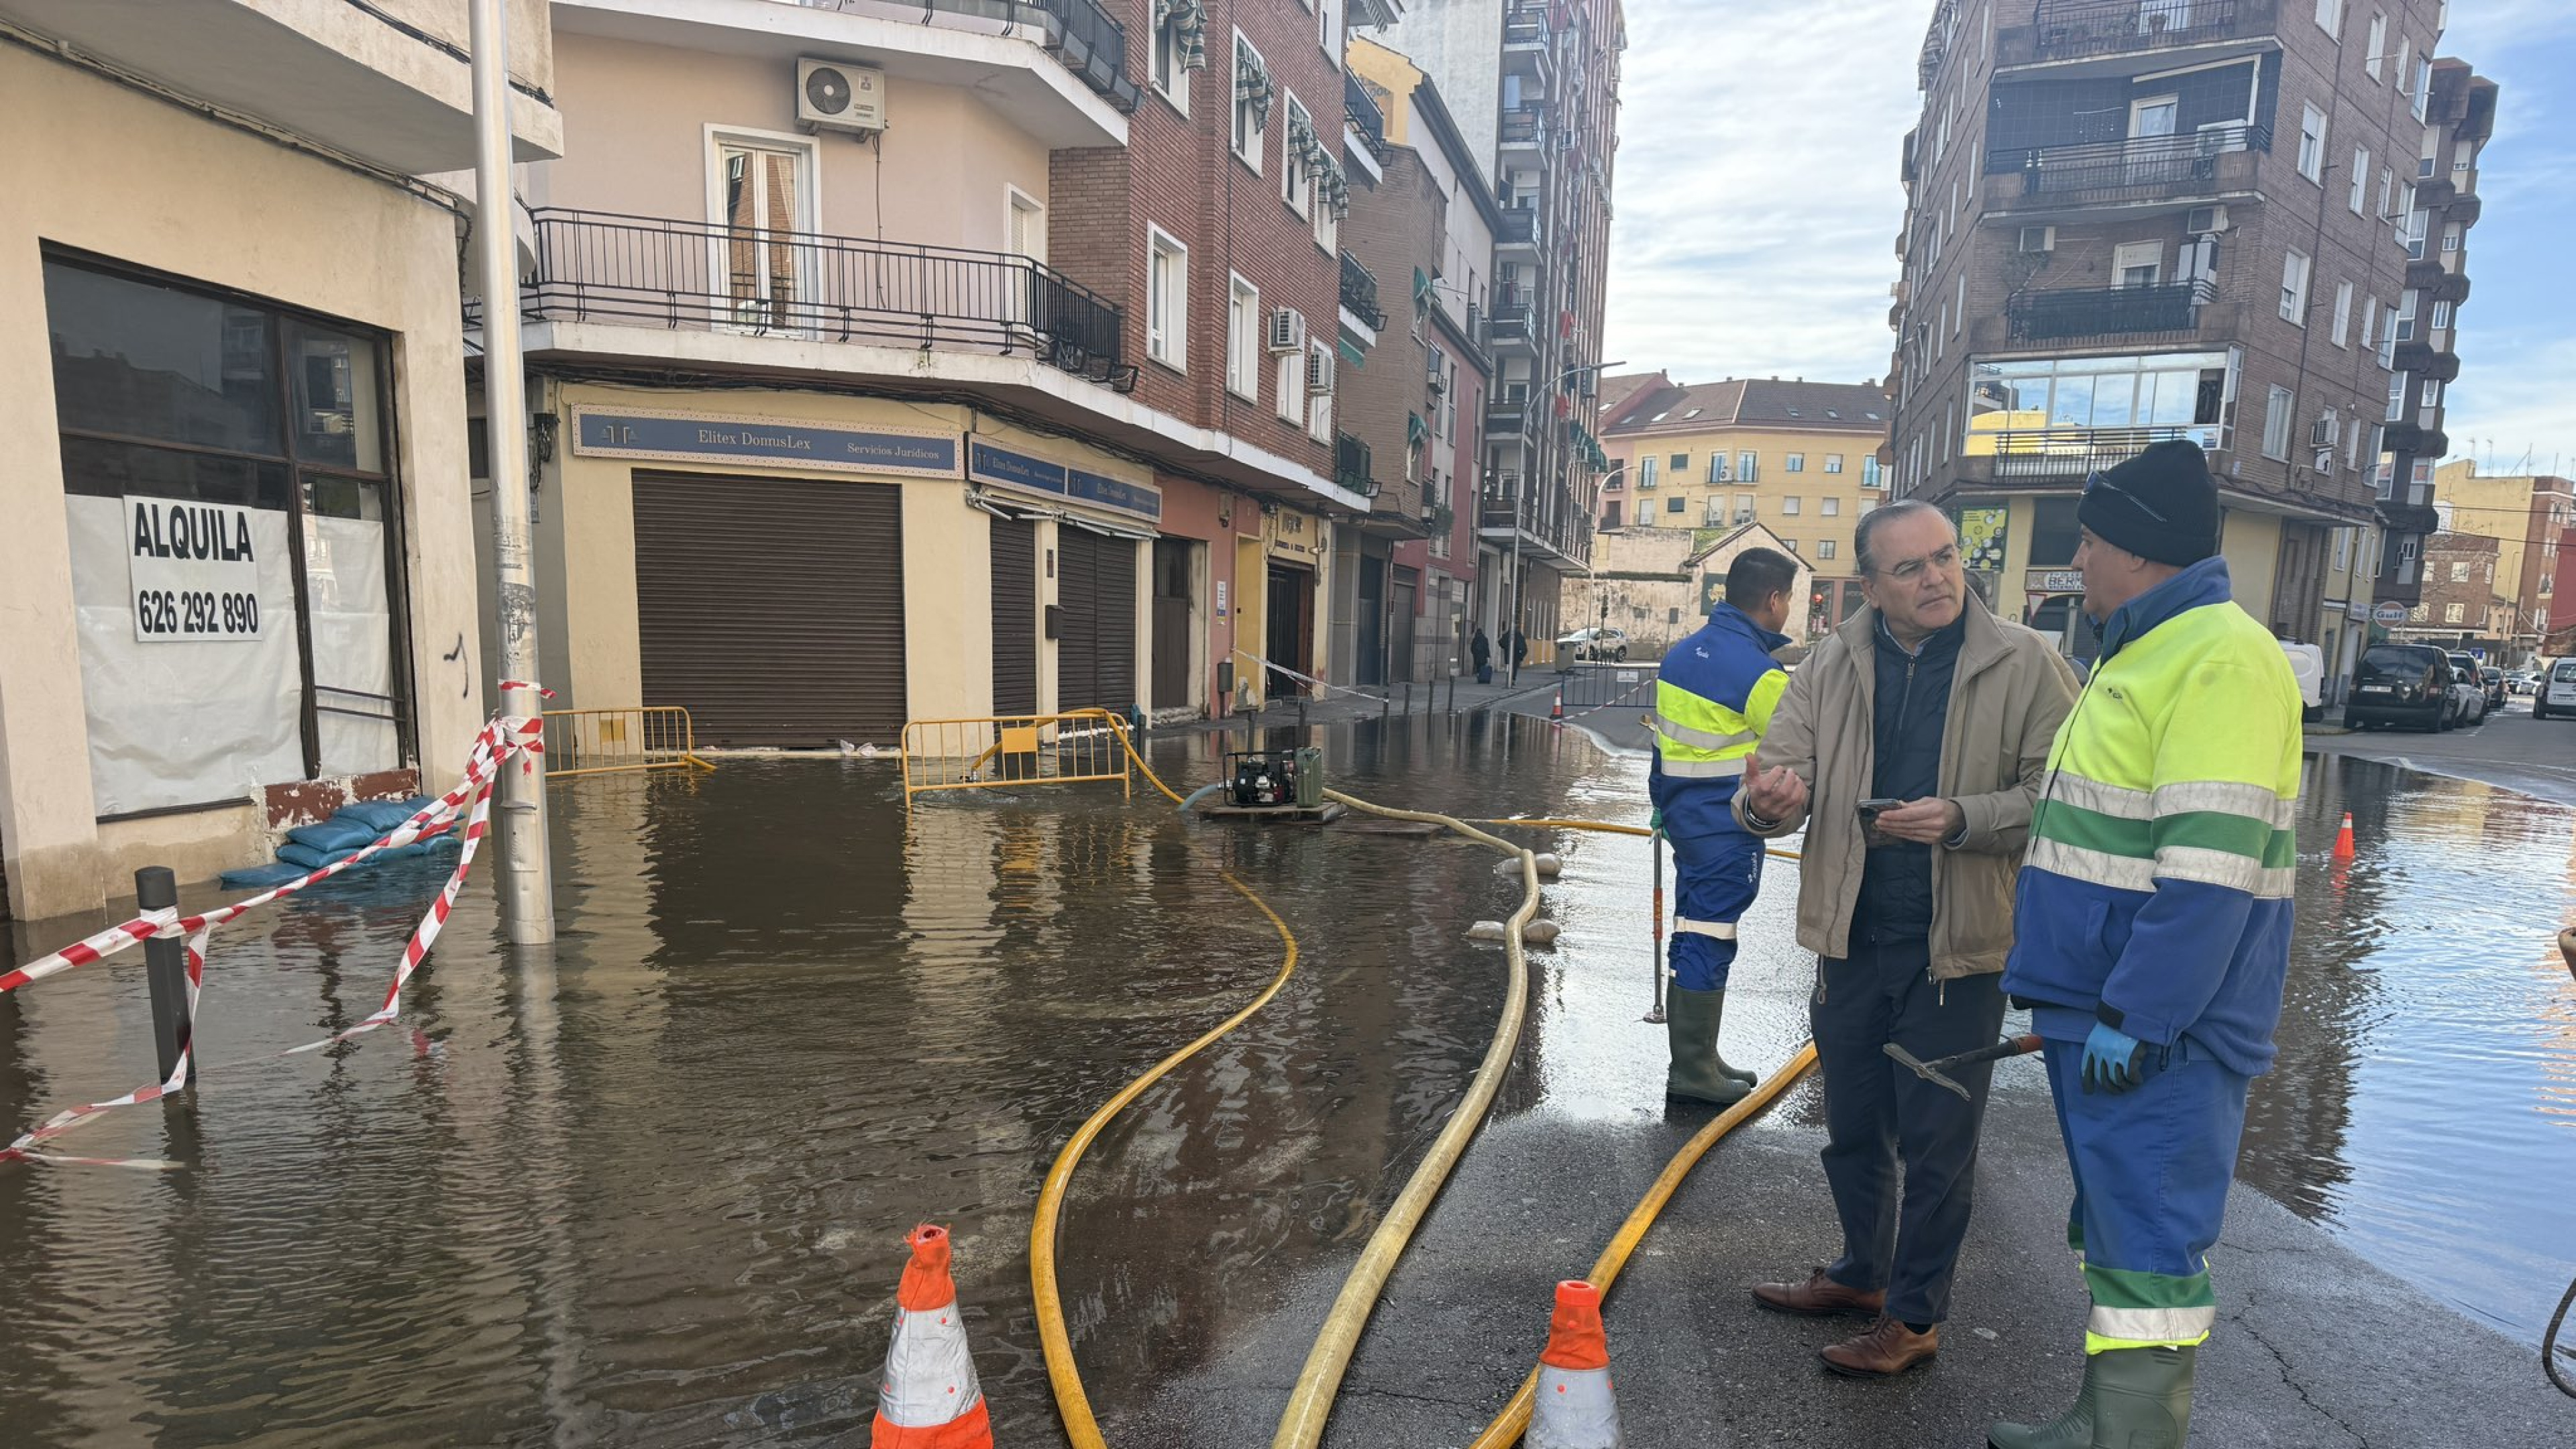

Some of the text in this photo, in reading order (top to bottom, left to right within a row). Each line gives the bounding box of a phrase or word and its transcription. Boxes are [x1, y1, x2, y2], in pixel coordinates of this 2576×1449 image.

[698, 429, 810, 449] Elitex DomusLex
[847, 442, 892, 455] Servicios
[134, 502, 254, 562] ALQUILA
[139, 590, 258, 633] 626 292 890
